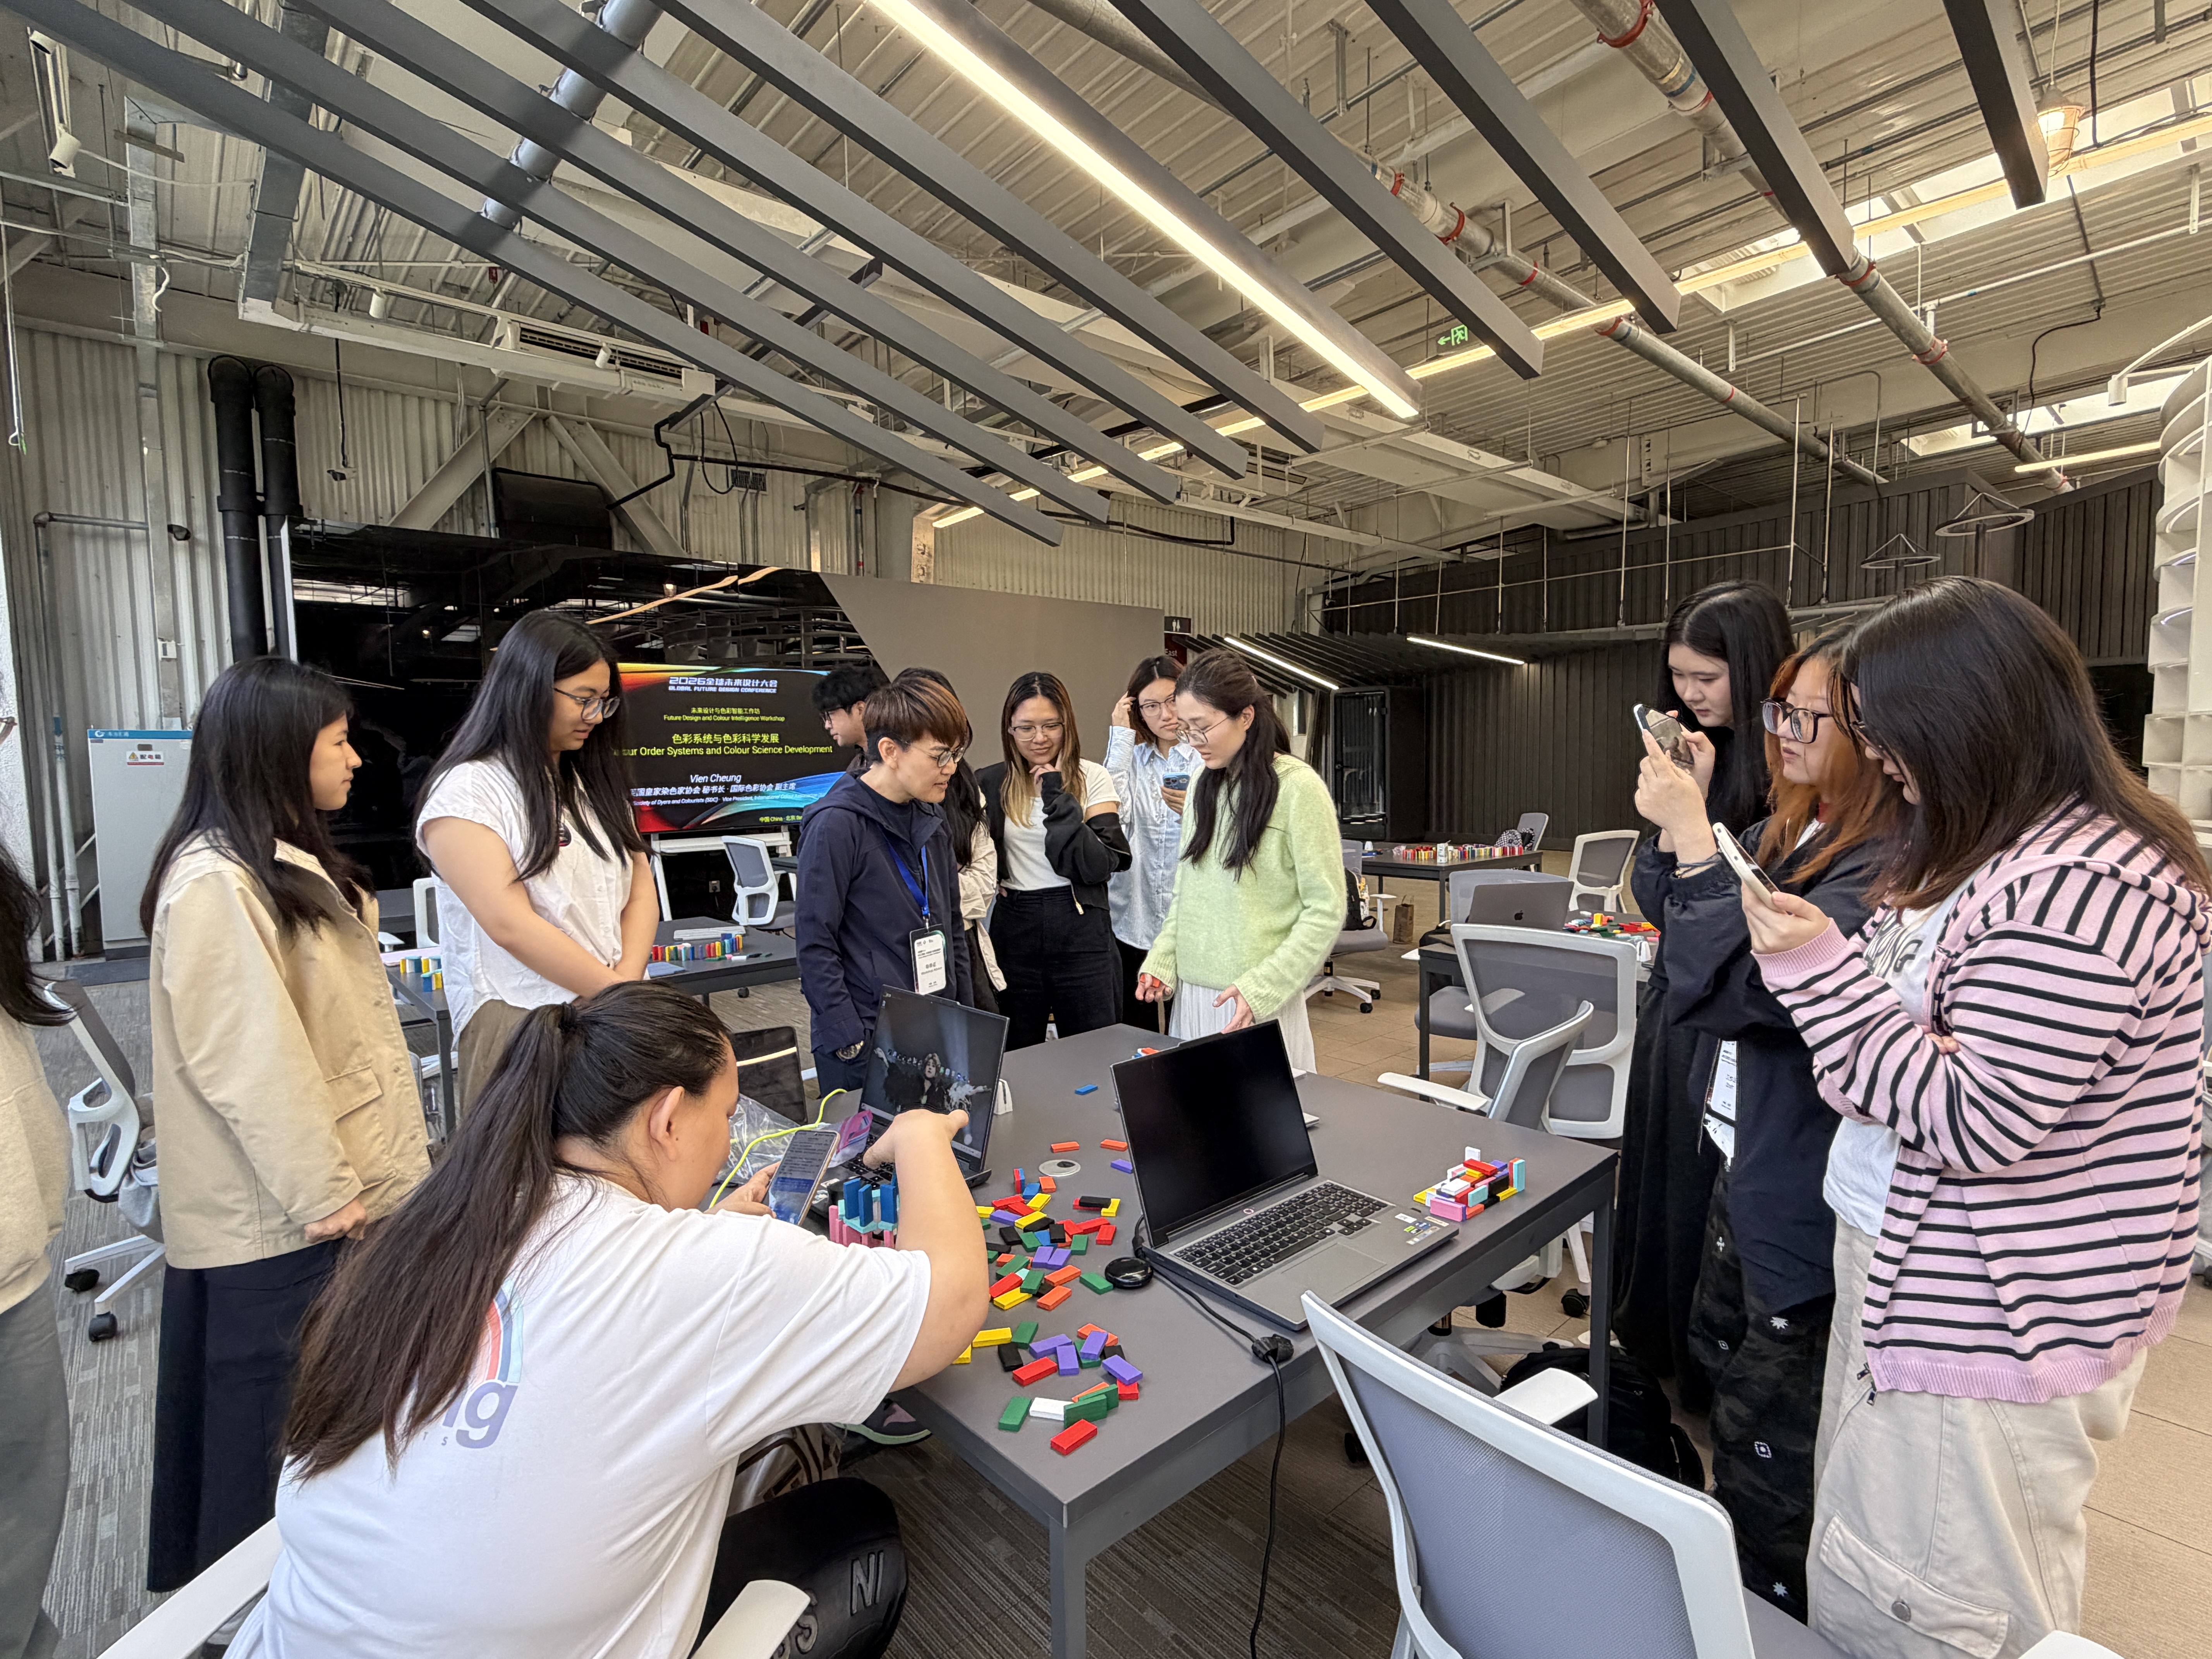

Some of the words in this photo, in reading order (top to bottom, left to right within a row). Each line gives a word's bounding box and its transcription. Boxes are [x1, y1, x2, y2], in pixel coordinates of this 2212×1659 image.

[672, 733, 780, 744] 色彩系统与色彩科学发展
[640, 746, 665, 756] Order
[666, 746, 704, 757] Systems
[706, 746, 722, 755] and
[723, 745, 750, 754] Colour
[752, 745, 783, 754] Science
[785, 745, 833, 755] Development
[690, 774, 709, 783] Vien
[710, 773, 742, 783] Cheung
[702, 785, 725, 794] 秘书长
[730, 783, 774, 793] 国际色彩协会
